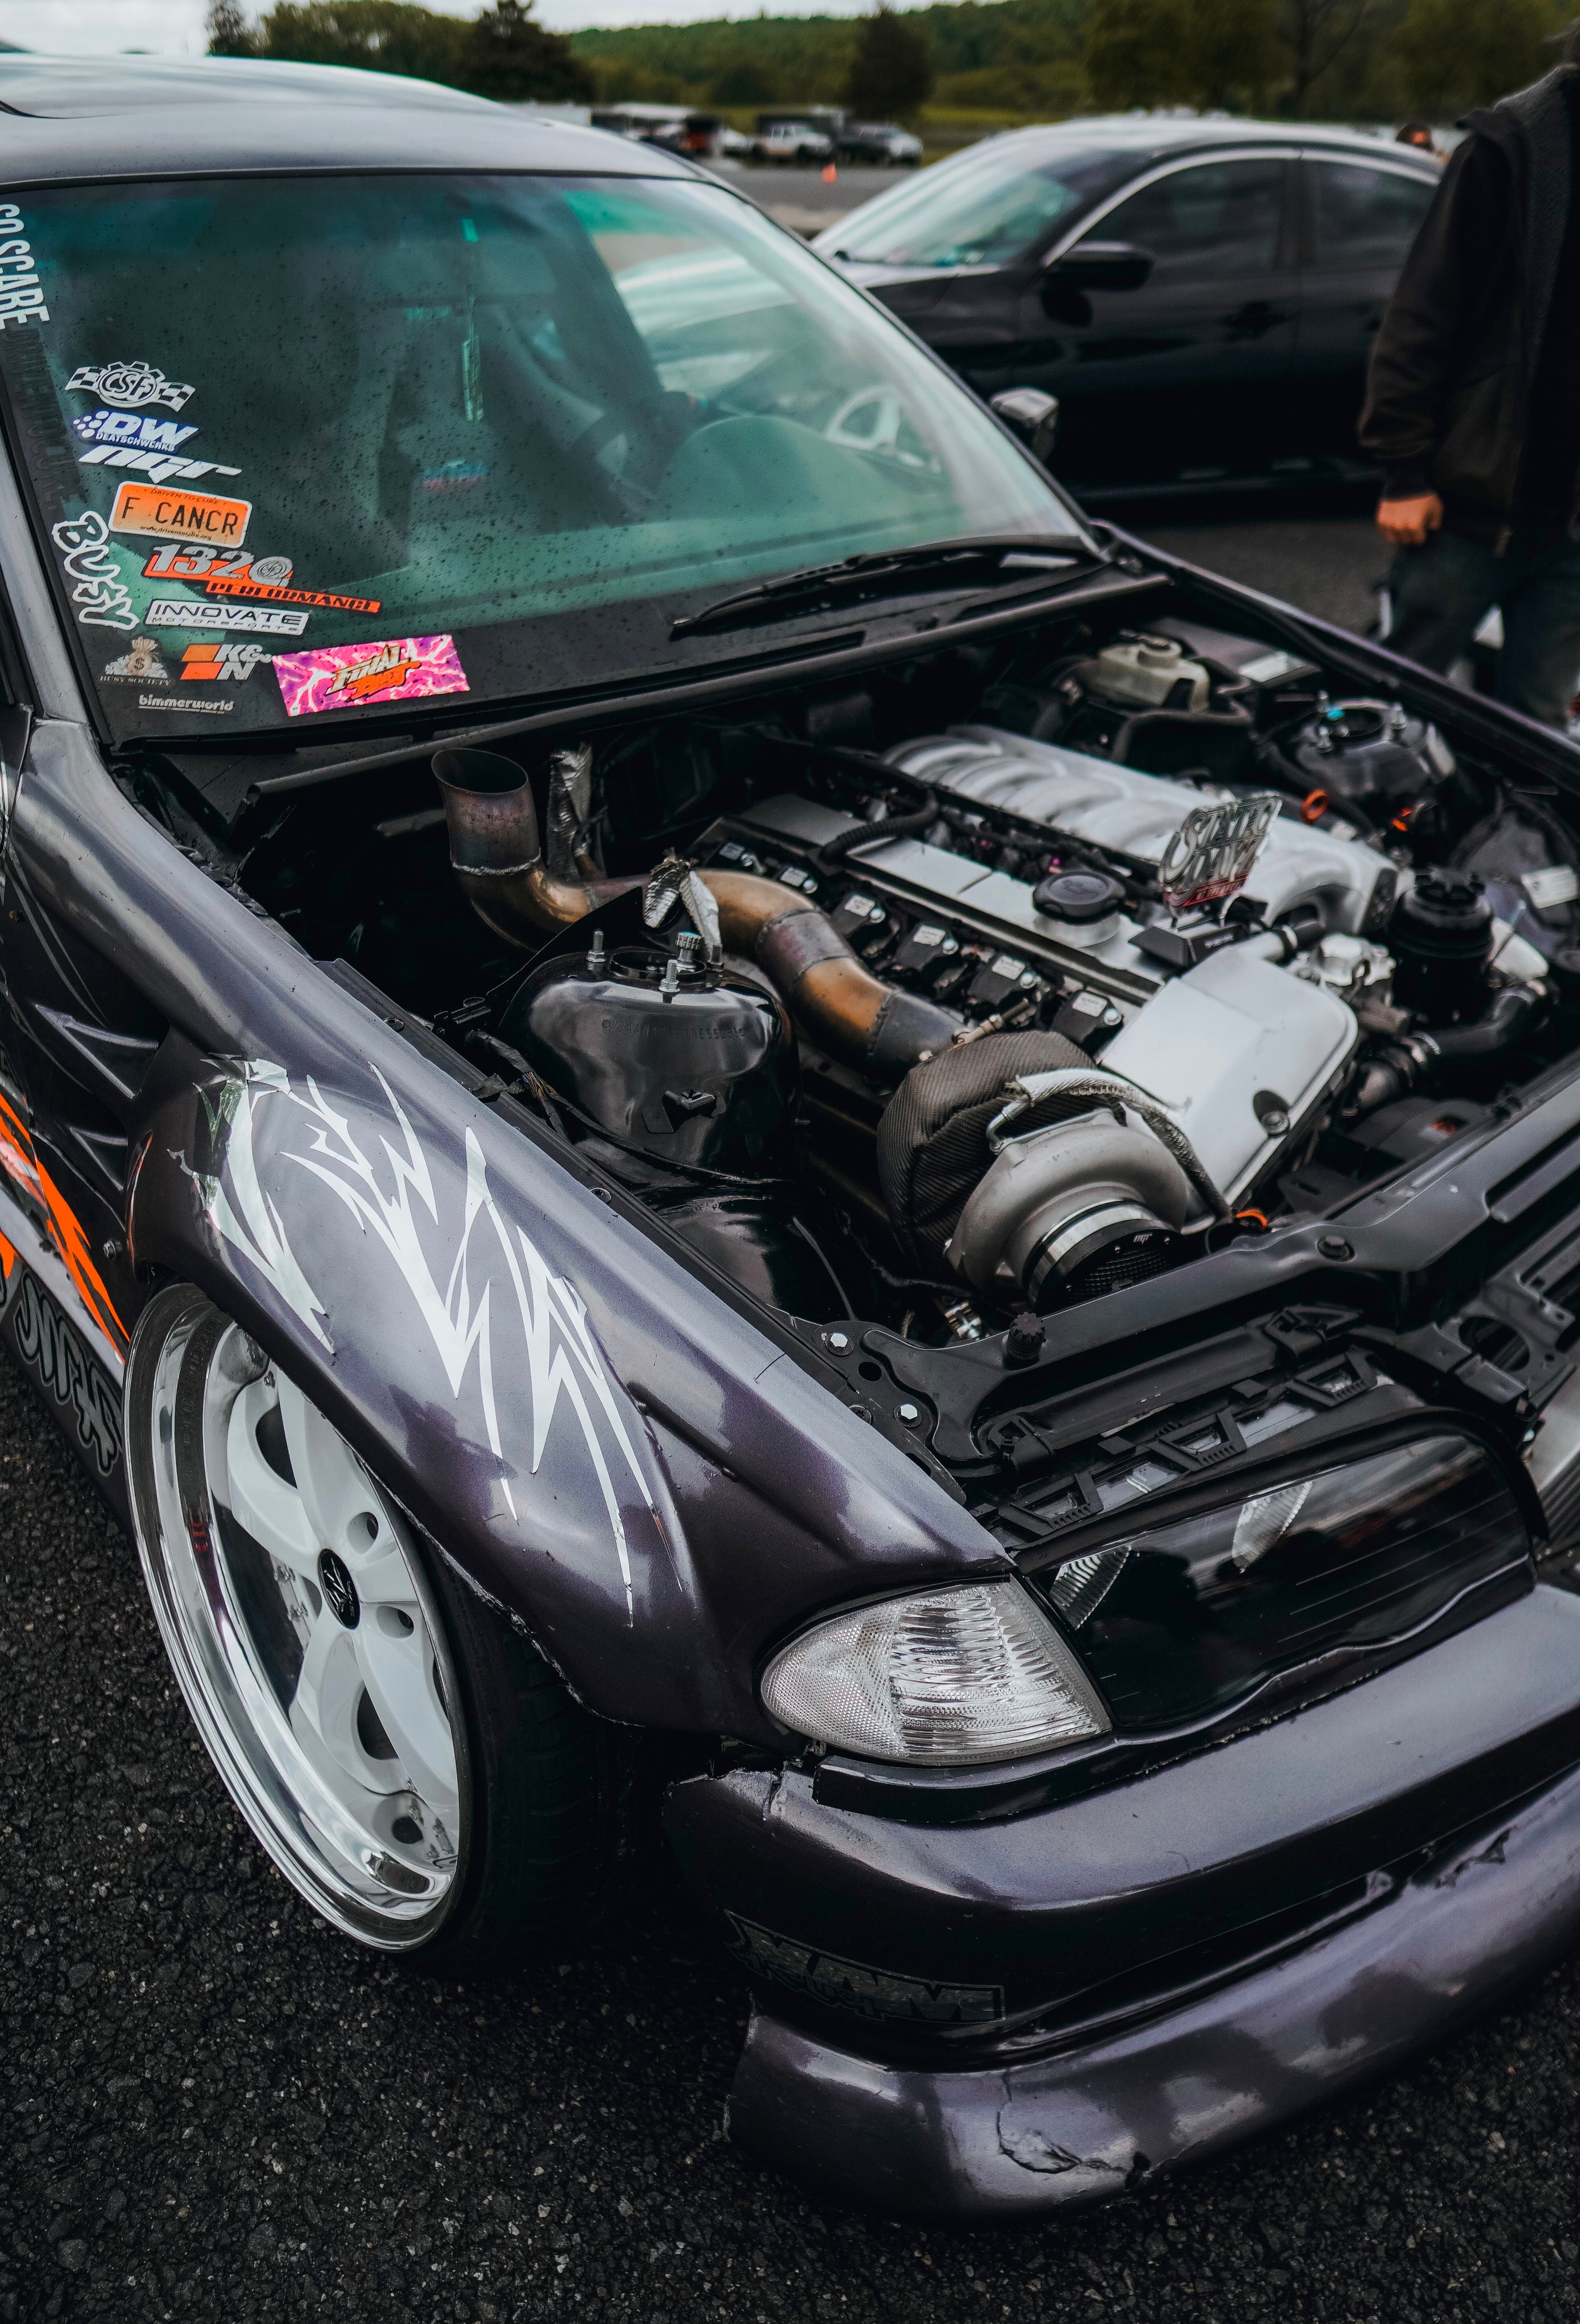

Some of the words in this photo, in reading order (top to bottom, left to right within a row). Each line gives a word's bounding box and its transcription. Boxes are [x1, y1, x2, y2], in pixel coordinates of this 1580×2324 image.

[0, 240, 50, 329] SCARE
[106, 370, 153, 402] CSF
[95, 432, 175, 452] DEATSCHWERKS
[98, 412, 199, 446] DW
[151, 489, 181, 498] DRIVEN
[122, 497, 140, 519] F
[155, 502, 238, 535] CANCR
[151, 617, 299, 631] MOTORSPORTS
[155, 604, 301, 626] INNOVATE
[214, 644, 273, 681] K&N
[139, 694, 235, 711] bimmerworld
